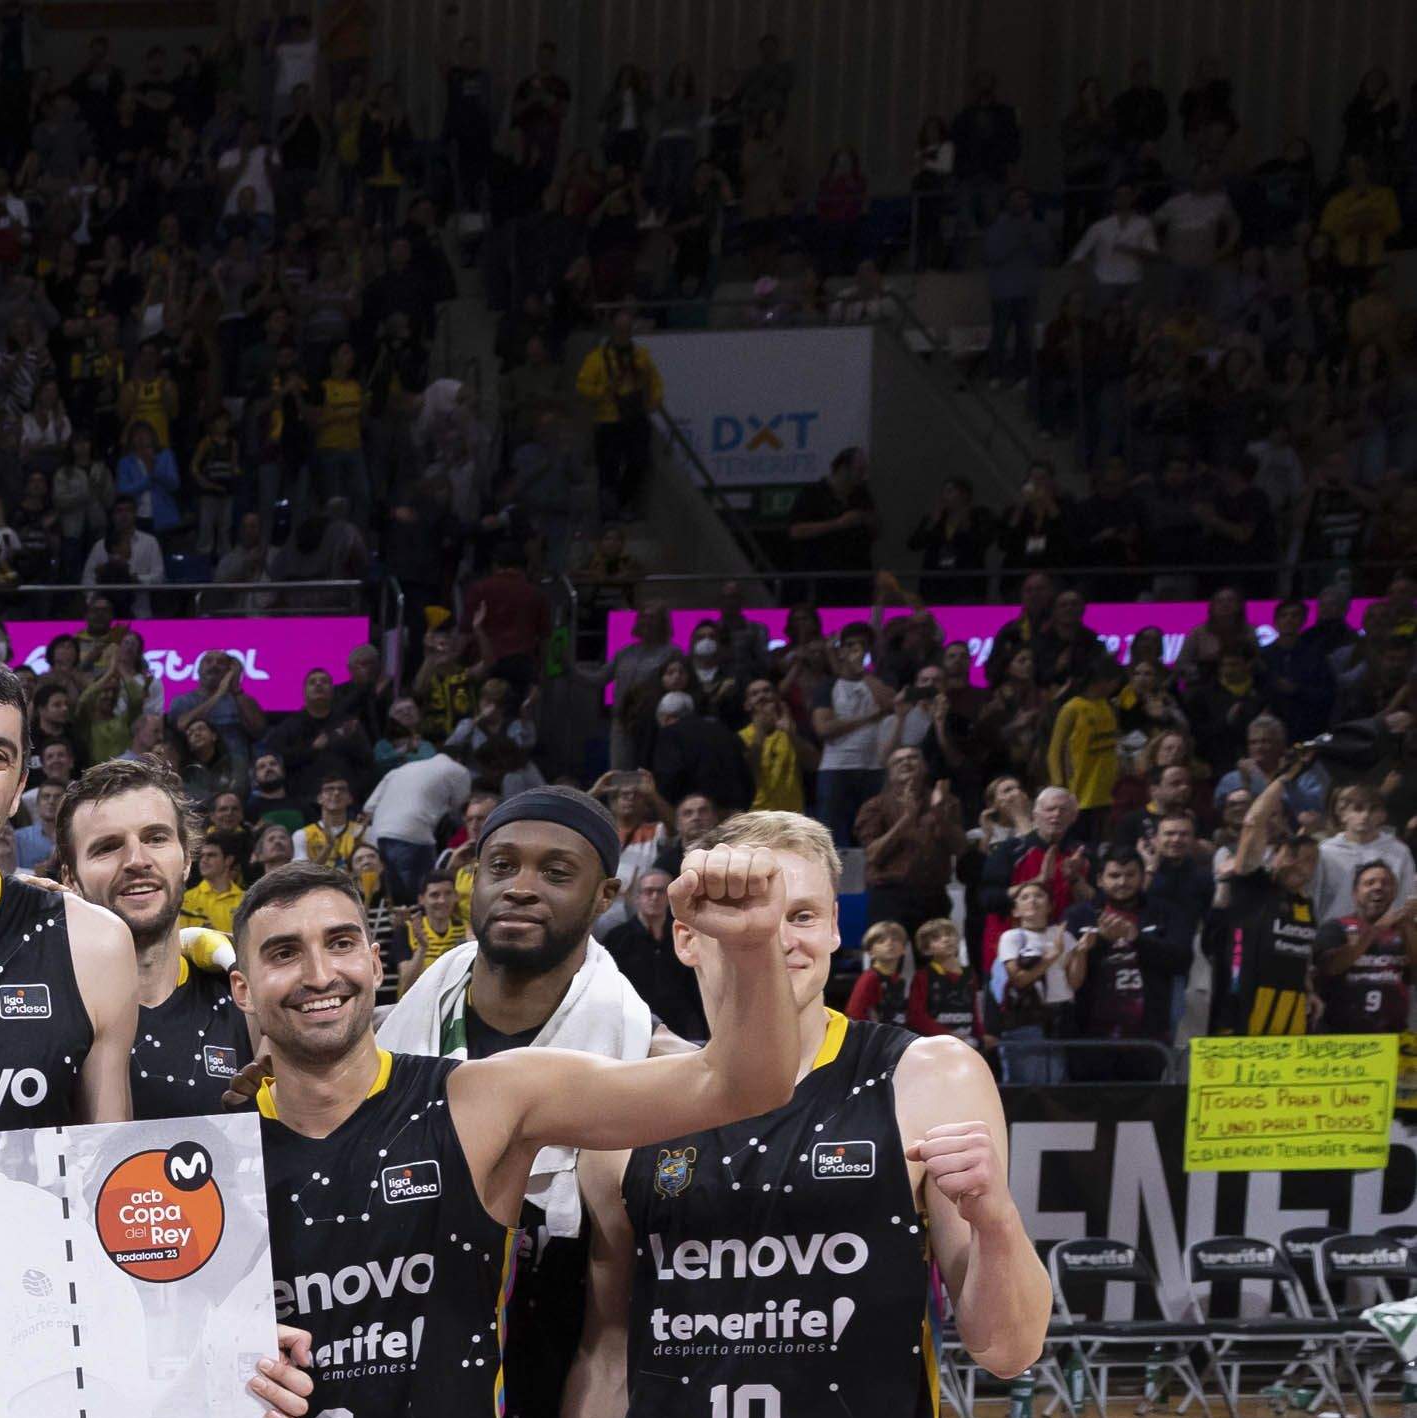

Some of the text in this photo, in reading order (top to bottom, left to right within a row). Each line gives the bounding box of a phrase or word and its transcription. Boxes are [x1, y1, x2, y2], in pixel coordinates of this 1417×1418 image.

[714, 413, 817, 451] DXT
[1115, 968, 1143, 990] 23
[4, 994, 23, 1006] liga
[1363, 987, 1381, 1011] 9
[5, 1003, 47, 1014] endesa
[819, 1154, 843, 1166] liga
[819, 1161, 870, 1174] endesa
[388, 1177, 411, 1190] liga
[390, 1183, 437, 1198] endesa
[131, 1189, 163, 1204] acb
[119, 1203, 182, 1226] Copa
[125, 1223, 192, 1247] del Rey
[115, 1251, 163, 1265] Badalona
[649, 1232, 869, 1280] Lenovo
[272, 1253, 435, 1320] enovo
[650, 1296, 856, 1352] tenerife!
[653, 1340, 826, 1357] despierta emociones
[323, 1362, 406, 1381] emociones
